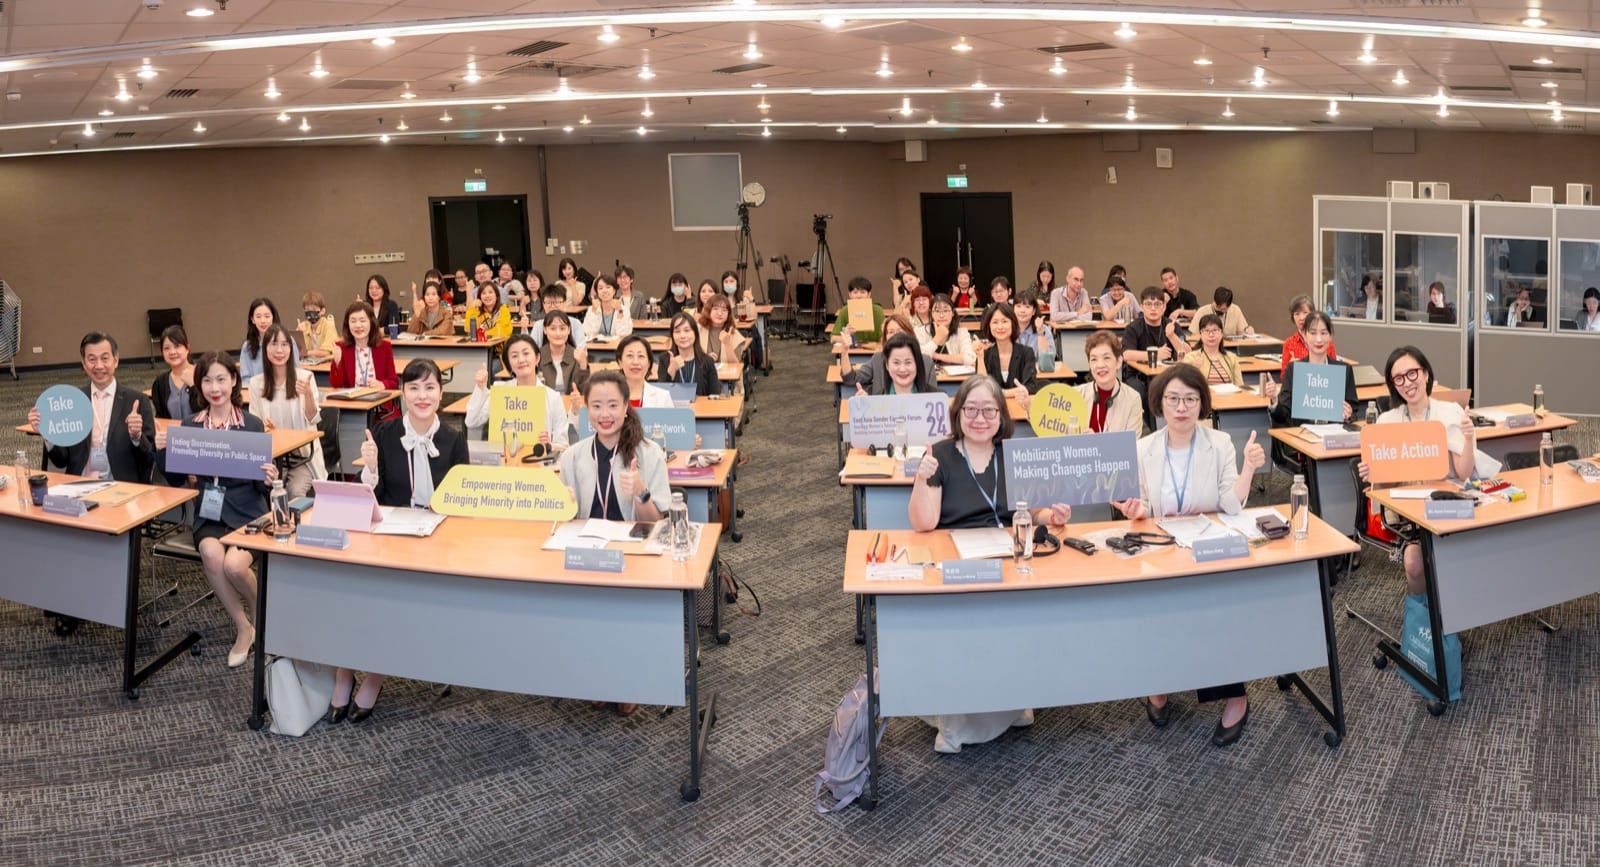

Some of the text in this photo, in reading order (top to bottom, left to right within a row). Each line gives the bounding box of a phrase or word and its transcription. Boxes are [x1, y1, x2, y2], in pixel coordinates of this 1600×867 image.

[1306, 373, 1329, 388] Take
[47, 396, 74, 412] Take
[504, 396, 528, 410] Take
[1048, 392, 1072, 412] Take
[1302, 393, 1334, 409] Action
[925, 401, 945, 422] 20
[48, 417, 83, 434] Action
[500, 417, 533, 433] Ation
[926, 415, 947, 437] 24
[171, 436, 190, 448] Ending
[1368, 440, 1440, 460] Take Action
[171, 446, 267, 464] Promoting Diversity in Public Space
[1012, 445, 1101, 462] Mobilizing Women,
[1014, 459, 1130, 480] Making Changes Happen
[461, 478, 547, 493] Empowering Women,
[443, 493, 565, 510] Bringing Minority into Politics
